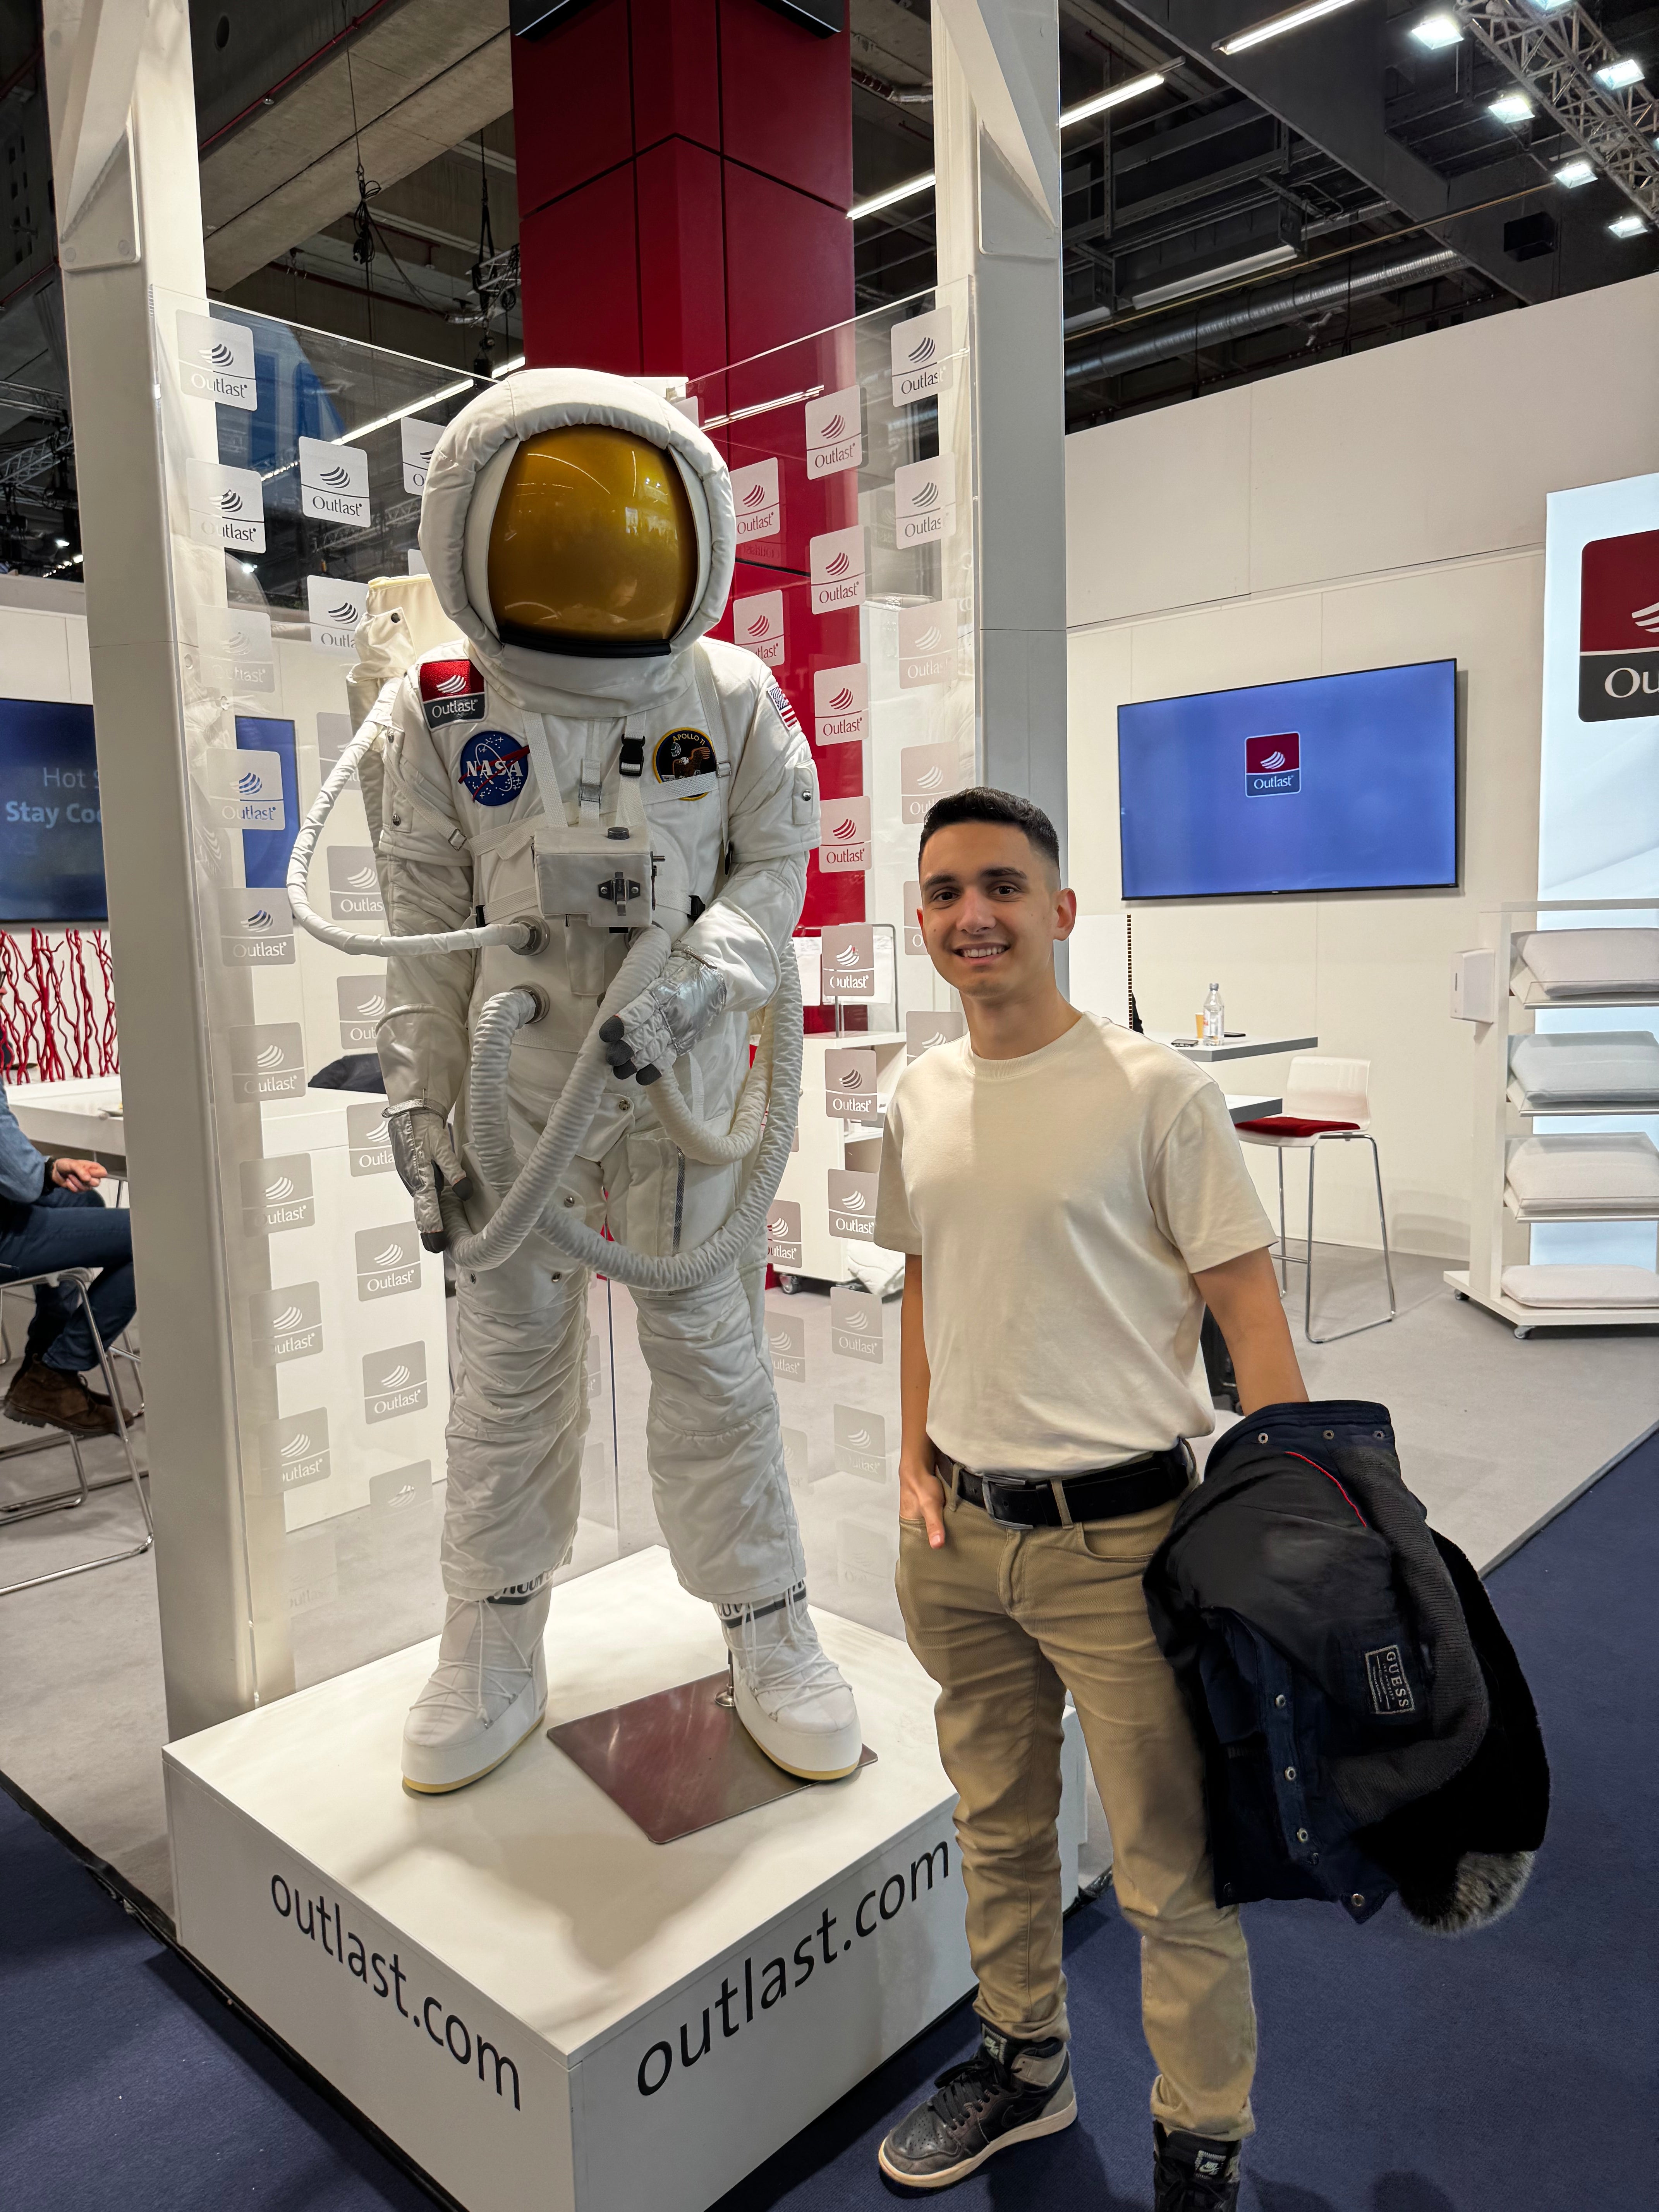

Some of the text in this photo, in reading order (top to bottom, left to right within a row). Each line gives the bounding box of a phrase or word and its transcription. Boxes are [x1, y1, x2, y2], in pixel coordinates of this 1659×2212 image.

[321, 633, 355, 647] Outla
[673, 733, 699, 742] APOLLO
[43, 767, 86, 788] Hot
[466, 760, 522, 778] NASA
[6, 800, 60, 828] Stay
[340, 898, 383, 912] Outlas
[359, 1150, 394, 1167] Outla
[768, 1244, 797, 1261] utlast
[283, 1458, 323, 1482] utlast
[1387, 1651, 1409, 1707] GUESS
[637, 1841, 948, 2096] outlast.com
[272, 1874, 520, 2111] outlast.com
